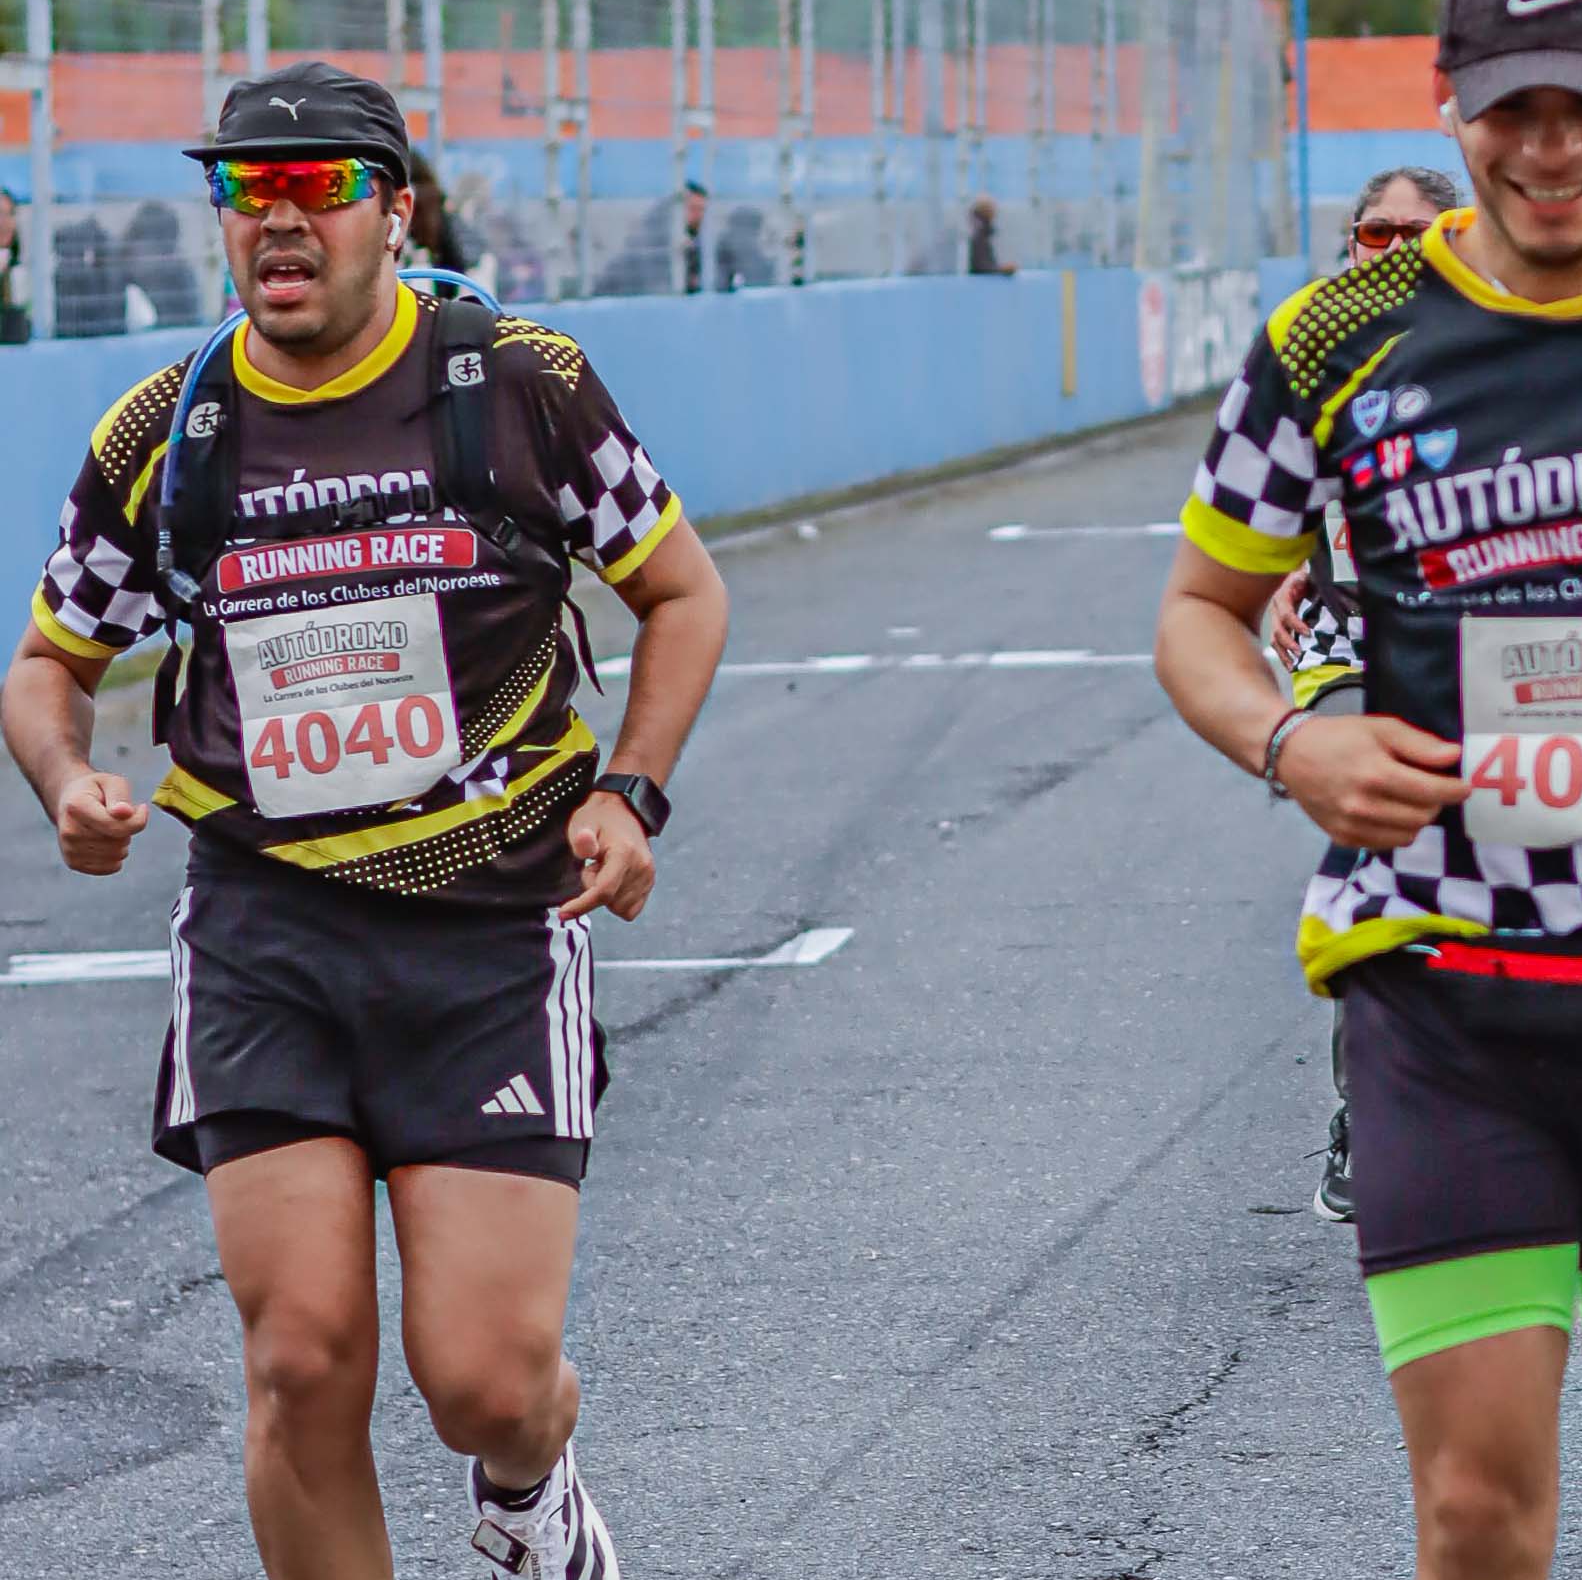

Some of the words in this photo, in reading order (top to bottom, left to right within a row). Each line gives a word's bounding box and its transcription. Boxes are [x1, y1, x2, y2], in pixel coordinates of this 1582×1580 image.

[240, 539, 362, 584] RUNNING
[370, 534, 446, 565] RACE
[203, 601, 218, 618] La
[219, 595, 273, 615] Carrera
[276, 590, 298, 608] de
[302, 588, 327, 606] los
[330, 584, 390, 603] Clubes
[393, 578, 421, 596] del
[423, 572, 500, 594] Noroeste
[257, 621, 409, 671] AUTÓDROMO
[263, 694, 273, 703] La
[274, 691, 302, 702] Carrera
[304, 687, 315, 697] de
[316, 685, 328, 695] los
[329, 681, 360, 692] Clubes
[360, 679, 374, 688] del
[284, 657, 344, 686] RUNNING
[347, 655, 385, 671] RACE
[251, 694, 445, 780] 4040
